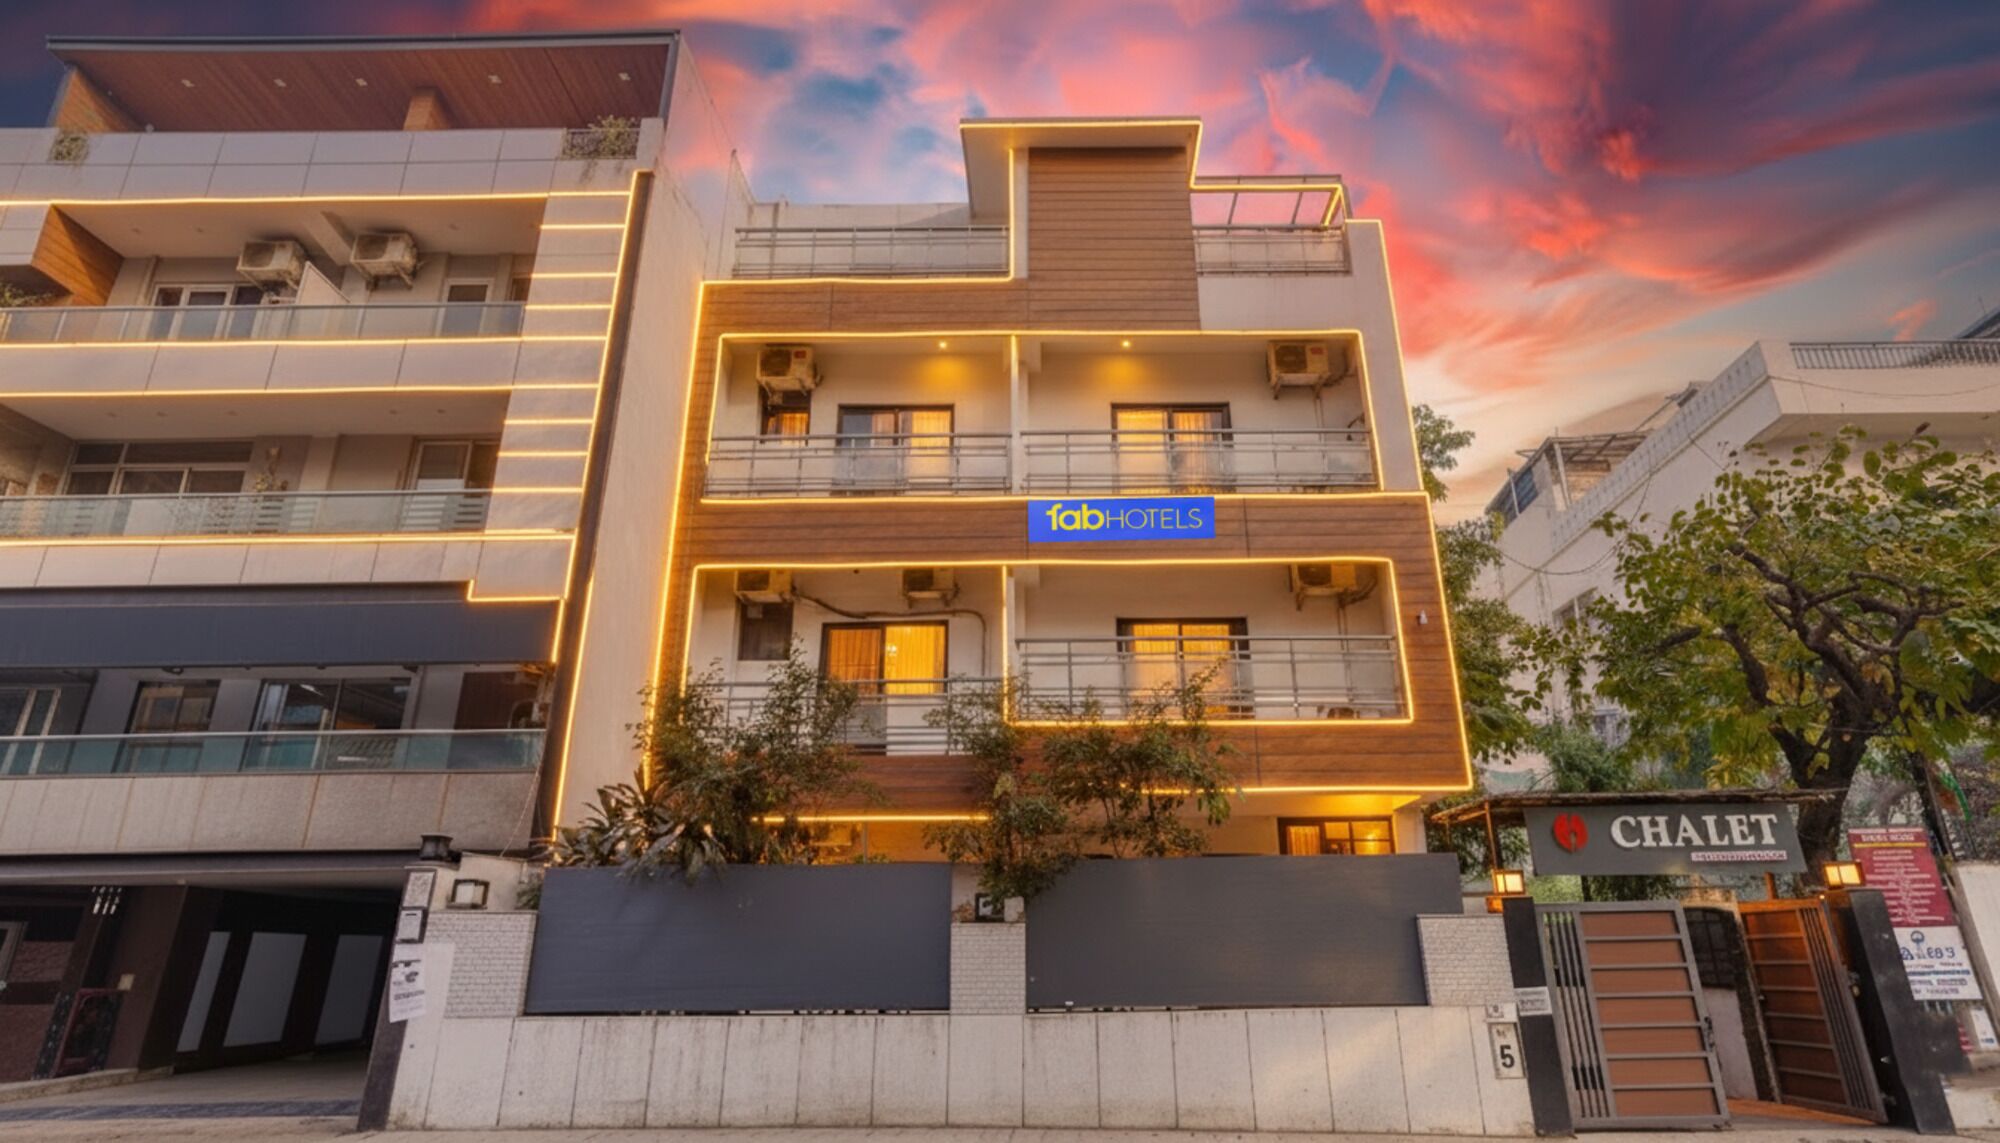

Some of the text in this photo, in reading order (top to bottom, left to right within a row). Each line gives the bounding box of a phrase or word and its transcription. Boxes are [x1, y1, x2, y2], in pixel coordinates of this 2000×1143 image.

[1046, 503, 1203, 531] fabHOTELS
[1610, 813, 1778, 848] CHALET
[1500, 1044, 1515, 1069] 5
